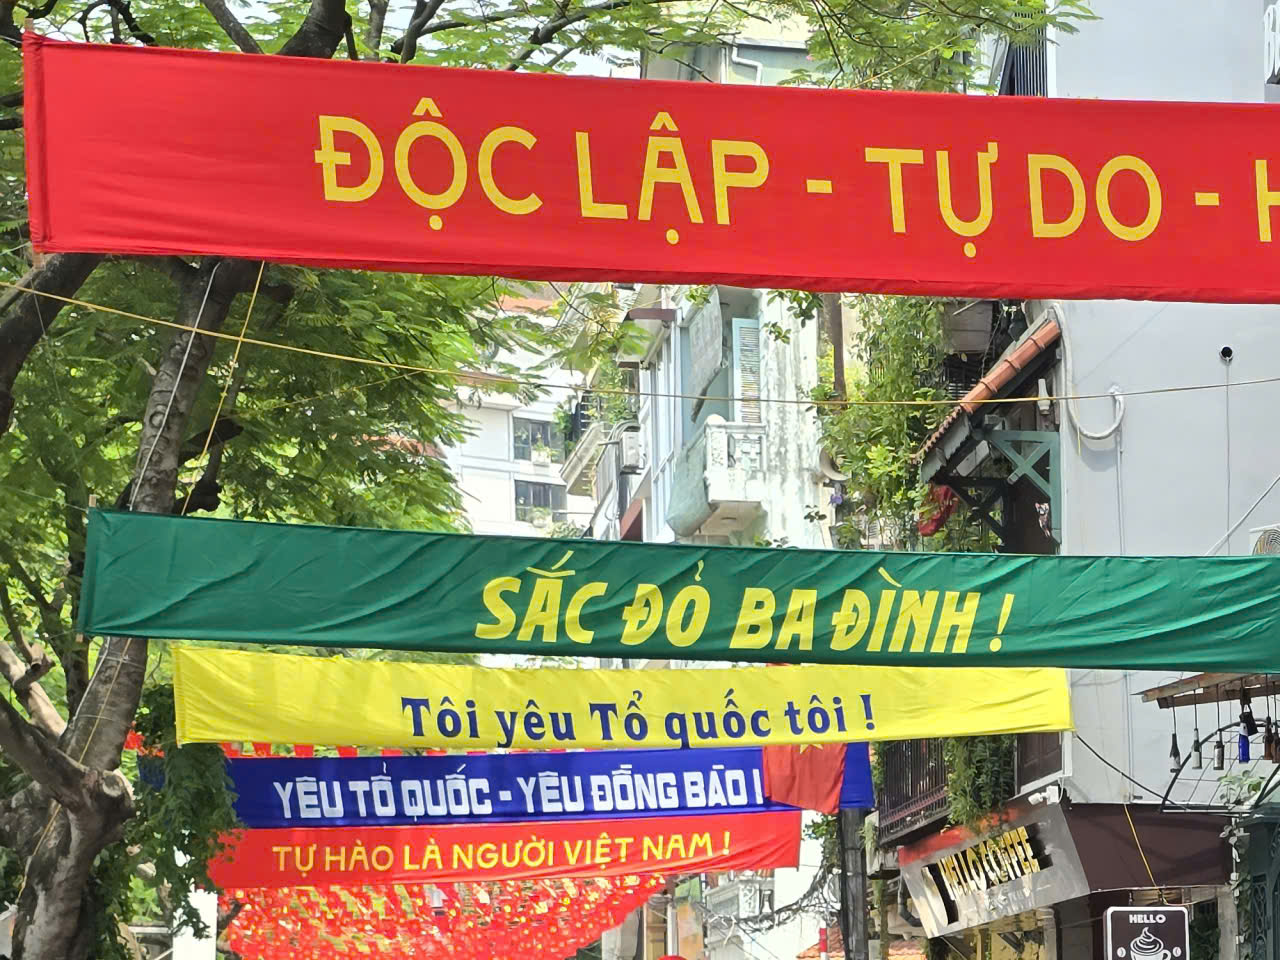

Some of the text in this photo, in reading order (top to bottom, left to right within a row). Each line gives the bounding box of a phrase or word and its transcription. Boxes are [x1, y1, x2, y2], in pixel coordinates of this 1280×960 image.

[314, 98, 543, 230] ĐỘC
[575, 111, 770, 245] LẬP
[865, 142, 999, 258] TỰ
[1028, 154, 1162, 242] DO
[475, 550, 1014, 653] SẮC ĐỎ BA ĐÌNH !
[401, 688, 875, 748] Tôi yêu Tổ quốc tôi !
[273, 776, 344, 818] YÊU
[348, 761, 396, 817] TỔ
[401, 763, 493, 821] QUỐC
[517, 771, 585, 813] YÊU
[590, 764, 678, 812] ĐỒNG
[272, 844, 317, 878] TỰ
[325, 839, 394, 871] HÀO
[403, 838, 443, 870] LÀ
[452, 835, 554, 869] NGƯỜI
[563, 831, 635, 870] VIỆT
[642, 832, 713, 861] NAM
[1129, 914, 1166, 923] HELLO
